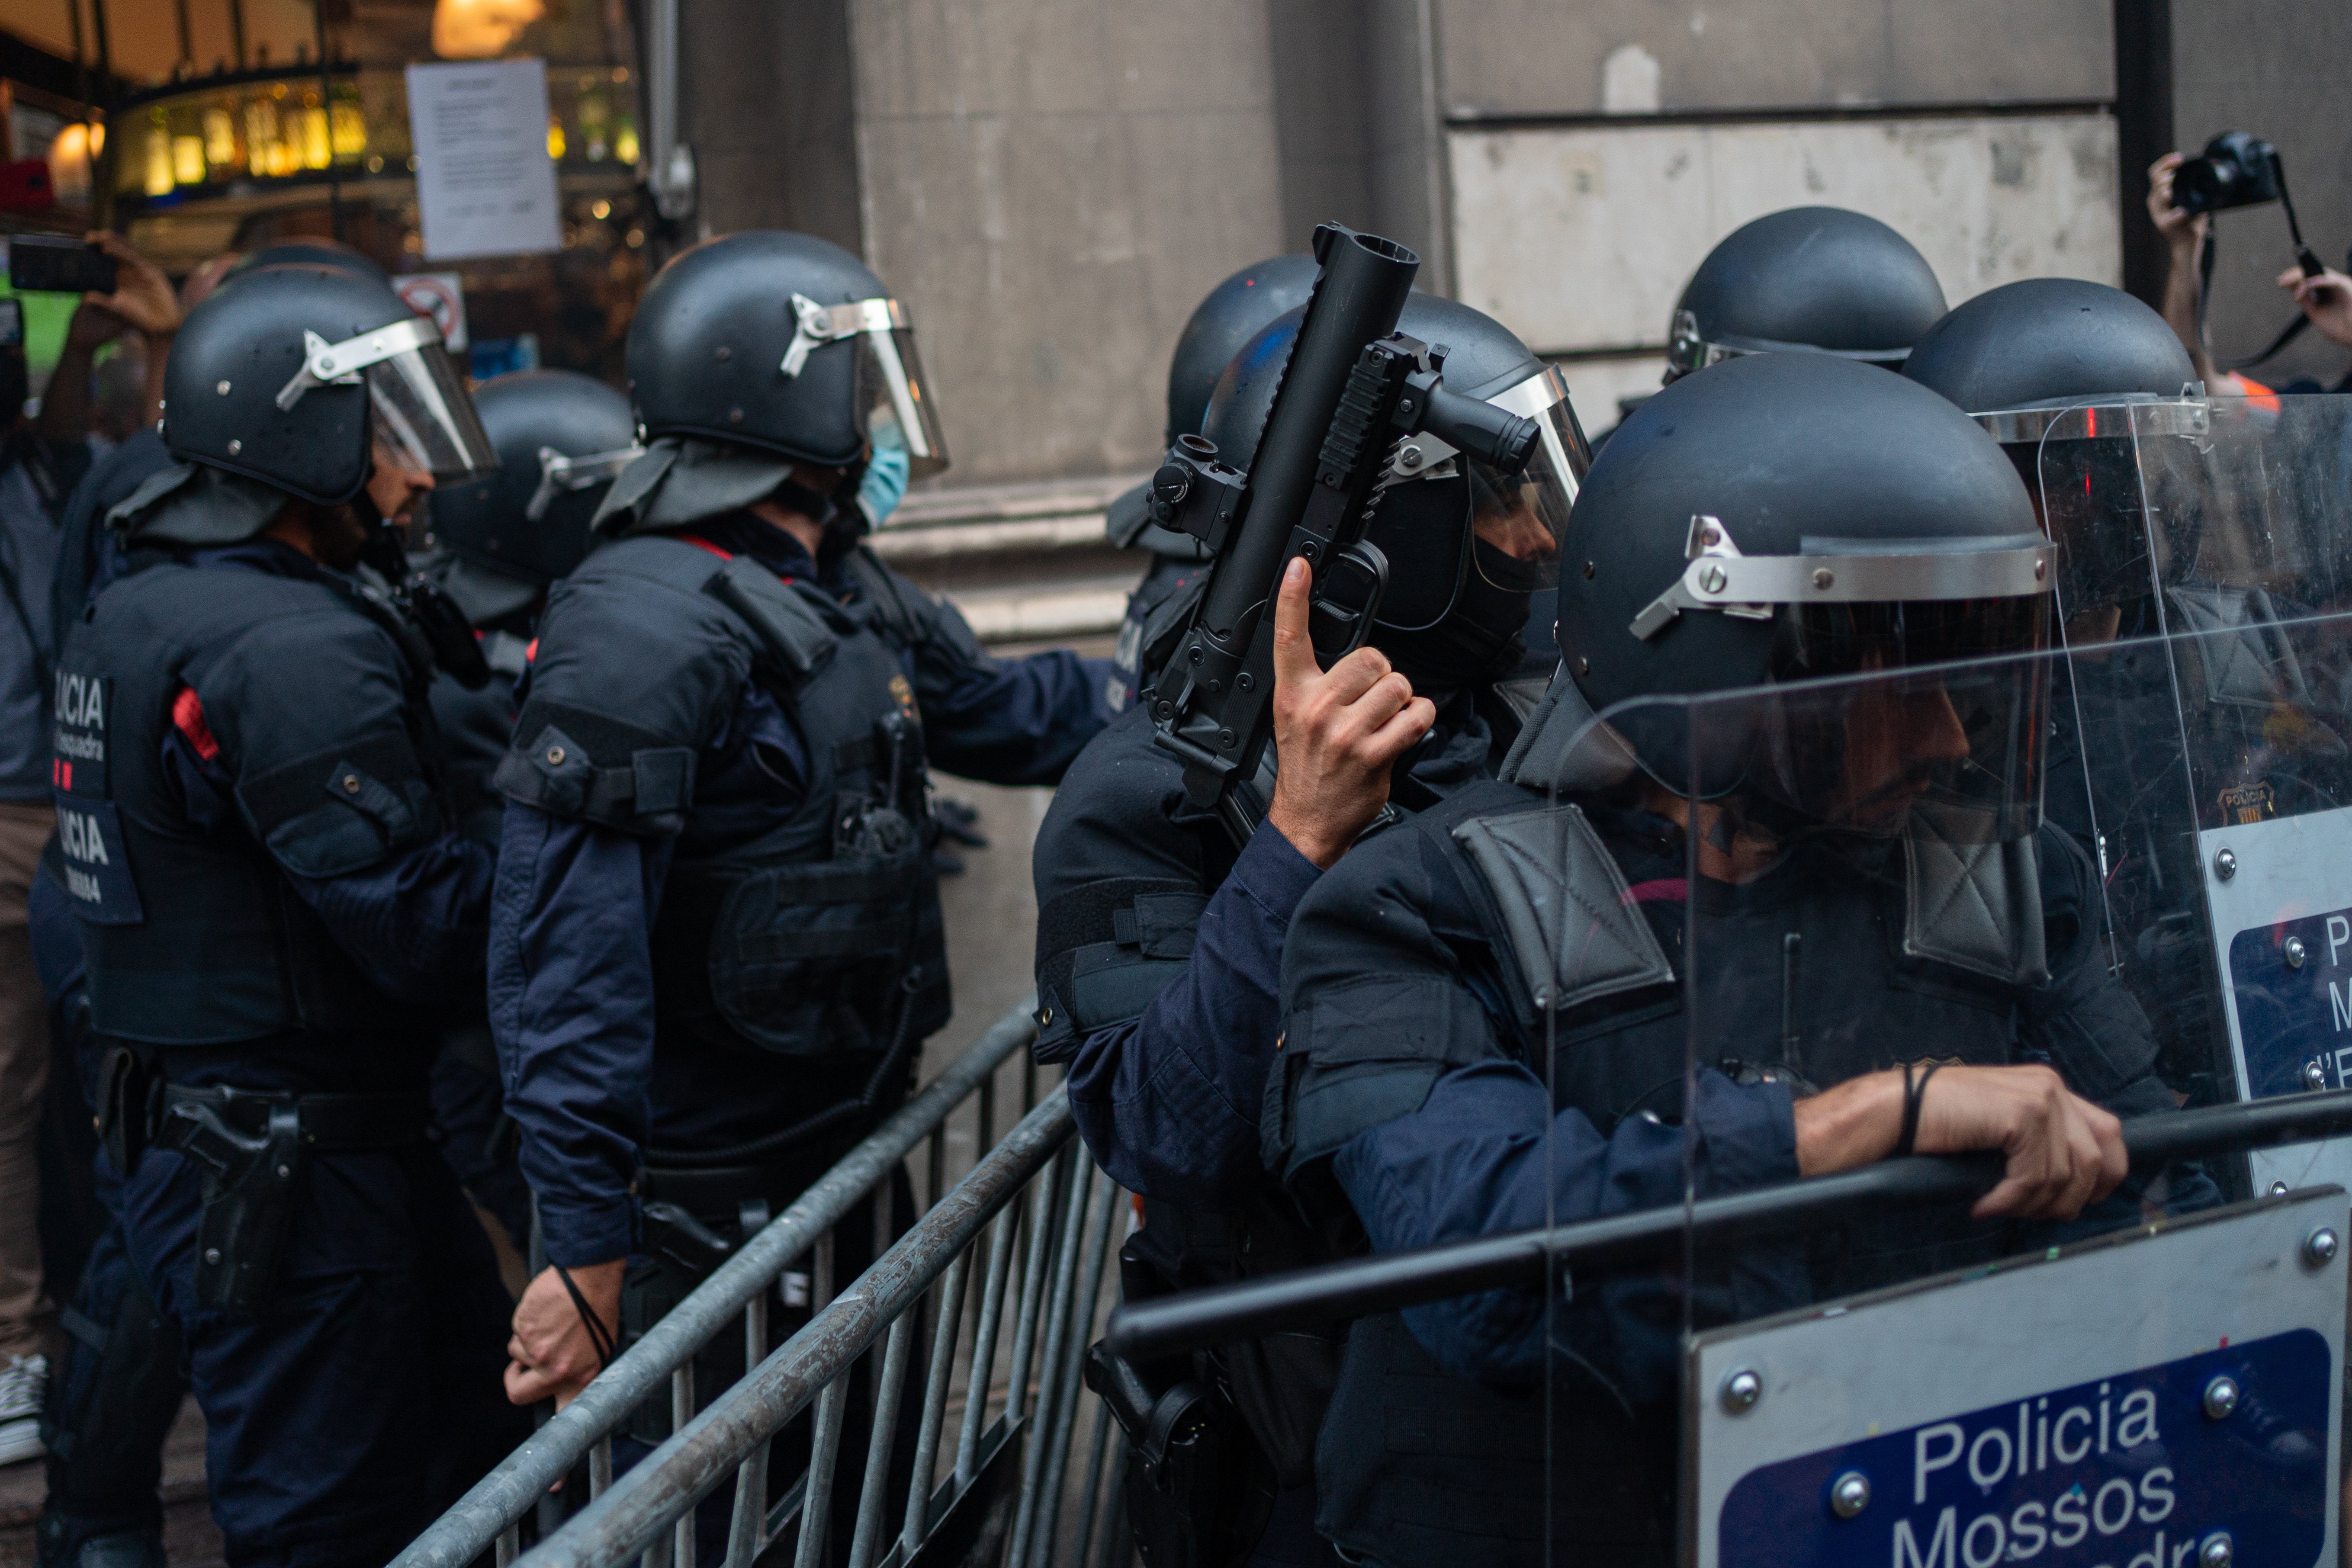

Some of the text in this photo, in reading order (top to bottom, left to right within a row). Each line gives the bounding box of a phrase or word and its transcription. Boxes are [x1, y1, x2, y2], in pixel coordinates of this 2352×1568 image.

[2226, 789, 2267, 807] POLICIA
[1913, 1382, 2159, 1506] Policia
[1892, 1465, 2175, 1568] Mossos
